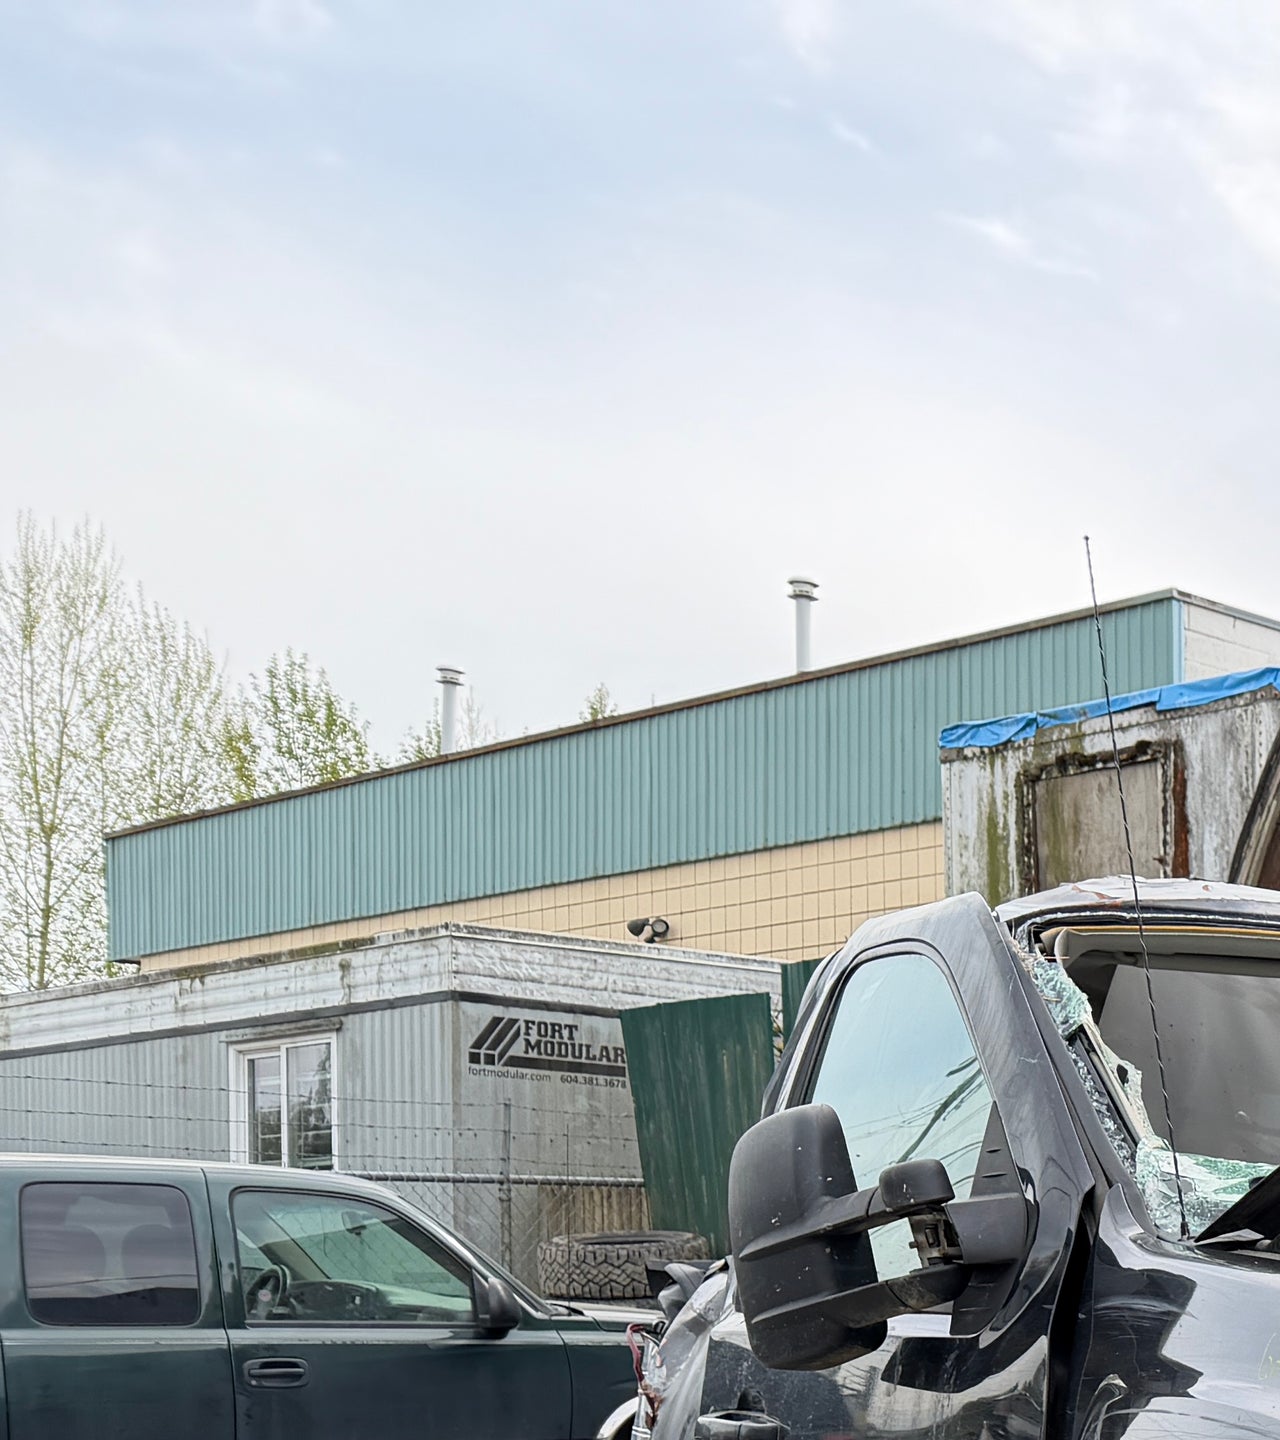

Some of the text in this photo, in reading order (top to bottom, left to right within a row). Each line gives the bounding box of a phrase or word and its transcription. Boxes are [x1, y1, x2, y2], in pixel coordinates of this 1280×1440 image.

[523, 1019, 579, 1041] FORT
[523, 1038, 626, 1064] MODULAR
[468, 1066, 627, 1089] fortmodular.com 604.381.3678
